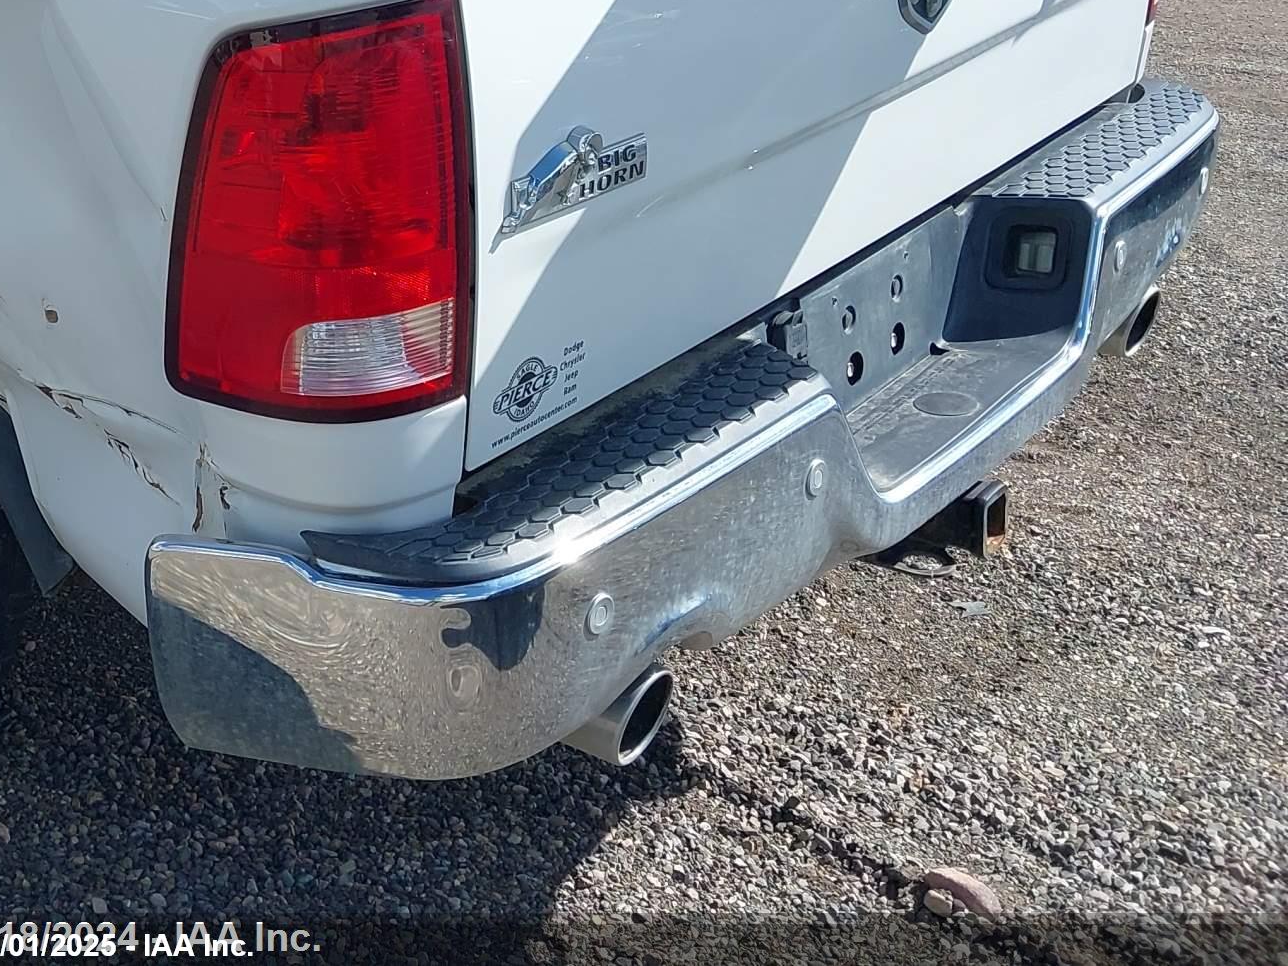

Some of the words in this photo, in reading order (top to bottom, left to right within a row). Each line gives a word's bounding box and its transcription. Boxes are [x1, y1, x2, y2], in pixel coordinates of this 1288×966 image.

[597, 143, 638, 172] BIG
[579, 160, 645, 198] HORN
[563, 340, 585, 357] Dodge
[559, 352, 586, 372] Chrysler
[564, 369, 580, 383] Jeep
[497, 369, 553, 412] PIERCE
[563, 383, 578, 397] Ram
[491, 396, 578, 449] www.pierceautocenter.com
